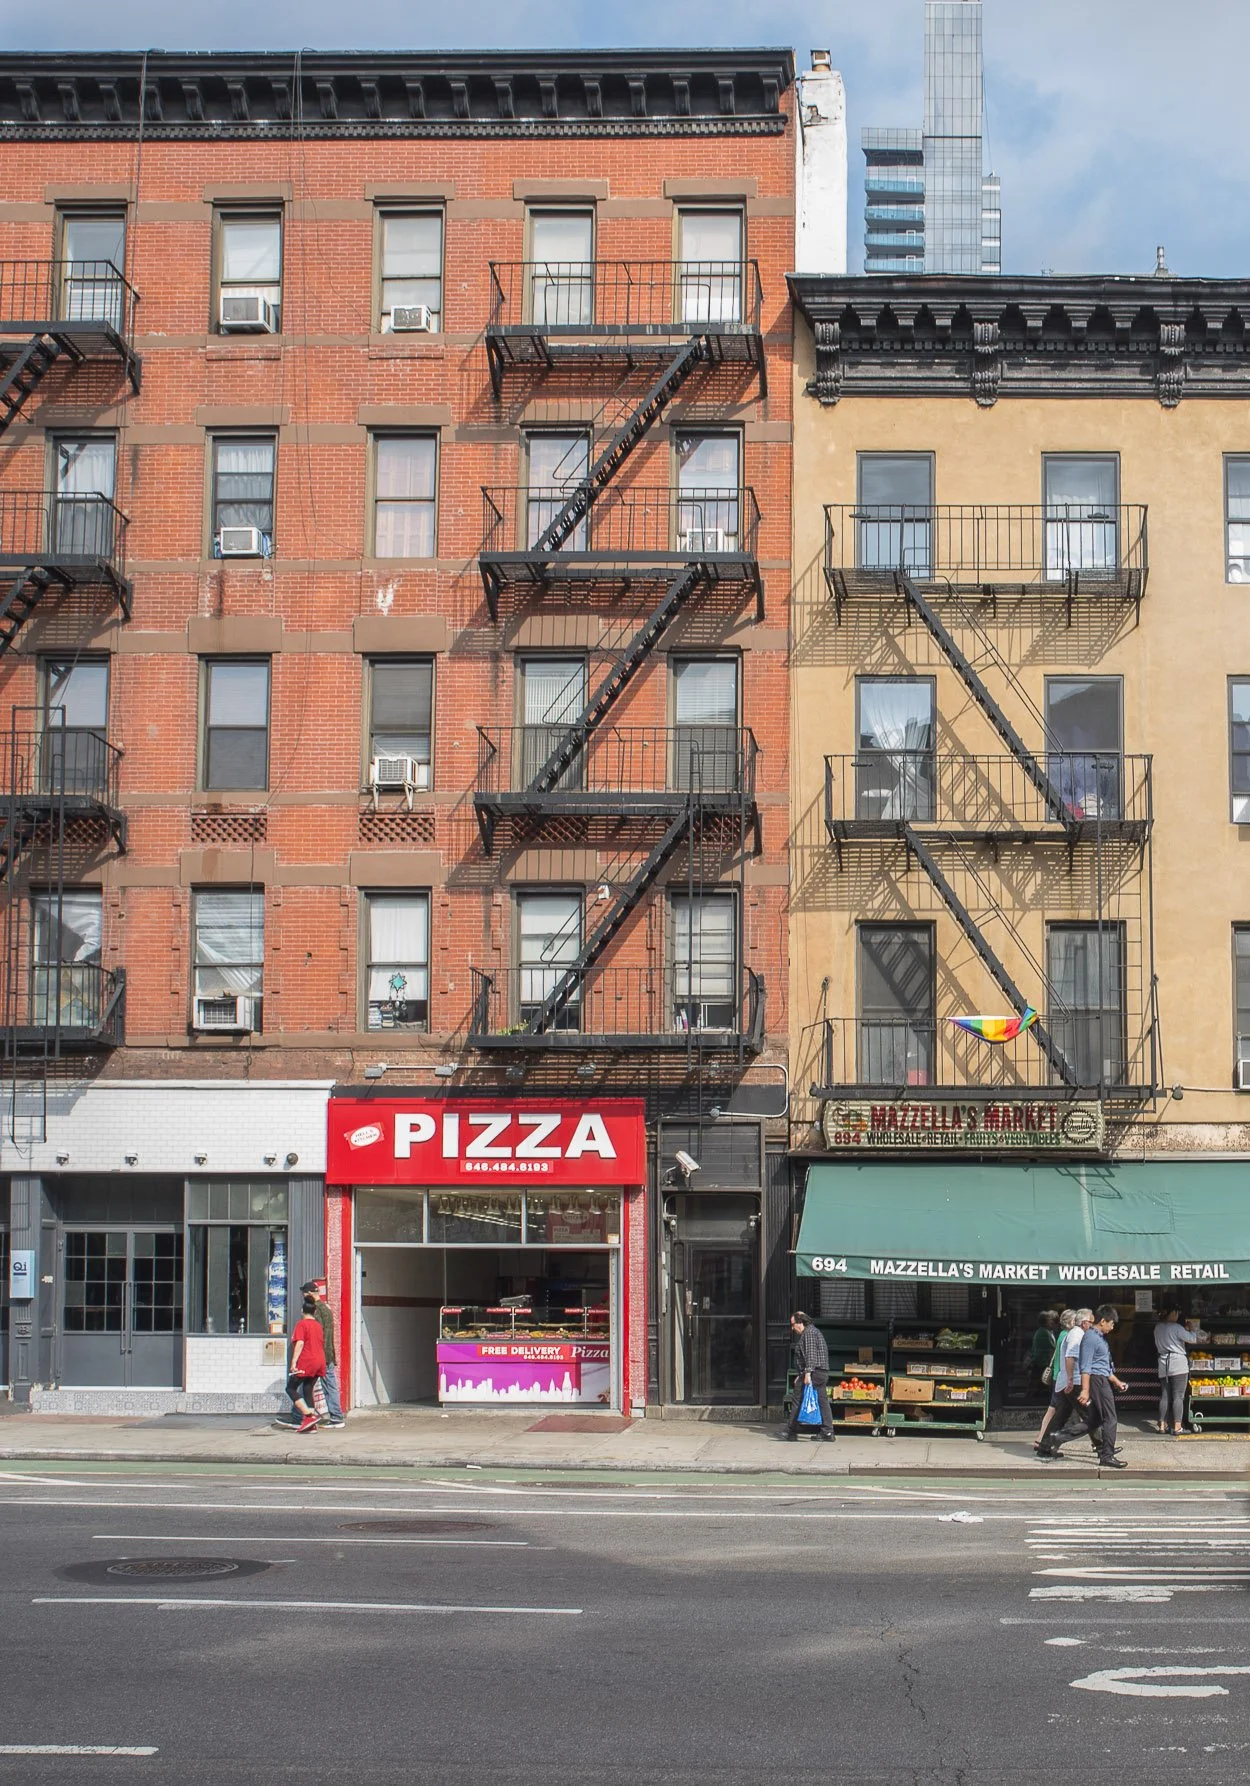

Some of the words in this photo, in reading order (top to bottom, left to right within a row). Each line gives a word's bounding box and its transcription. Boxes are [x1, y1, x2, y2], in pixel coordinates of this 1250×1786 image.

[870, 1104, 978, 1131] MAZZELLA'S
[983, 1104, 1058, 1132] MARKET
[394, 1113, 617, 1159] PIZZA
[867, 1132, 922, 1145] WHOLESALE
[927, 1132, 958, 1145] RETAIL
[964, 1132, 998, 1145] FRUITS
[1004, 1132, 1060, 1145] VEGETABLES
[812, 1257, 848, 1272] 694
[871, 1259, 975, 1278] MAZZELLA'S
[979, 1264, 1050, 1279] MARKET
[1058, 1265, 1161, 1280] WHOLESALE
[1170, 1263, 1229, 1279] RETAIL
[482, 1347, 507, 1355] FREE
[511, 1347, 561, 1355] DELIVERY
[571, 1346, 608, 1358] Pizza
